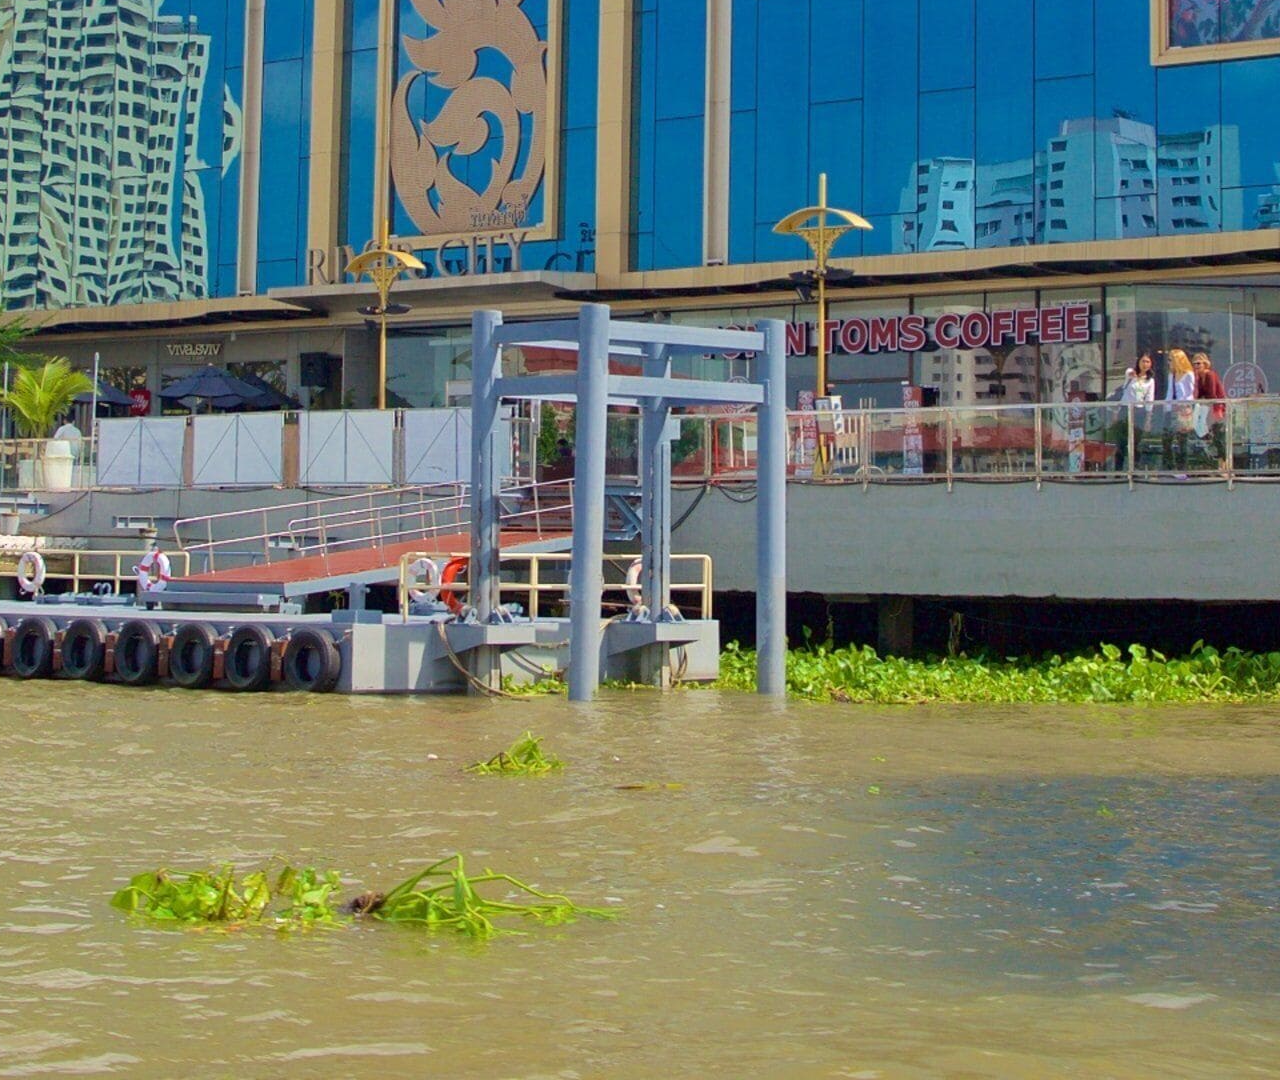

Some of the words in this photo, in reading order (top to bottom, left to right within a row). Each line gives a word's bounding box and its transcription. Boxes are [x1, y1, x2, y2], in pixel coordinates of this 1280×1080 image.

[435, 231, 527, 277] CITY
[816, 314, 927, 354] TOMS
[934, 303, 1090, 348] COFFEE
